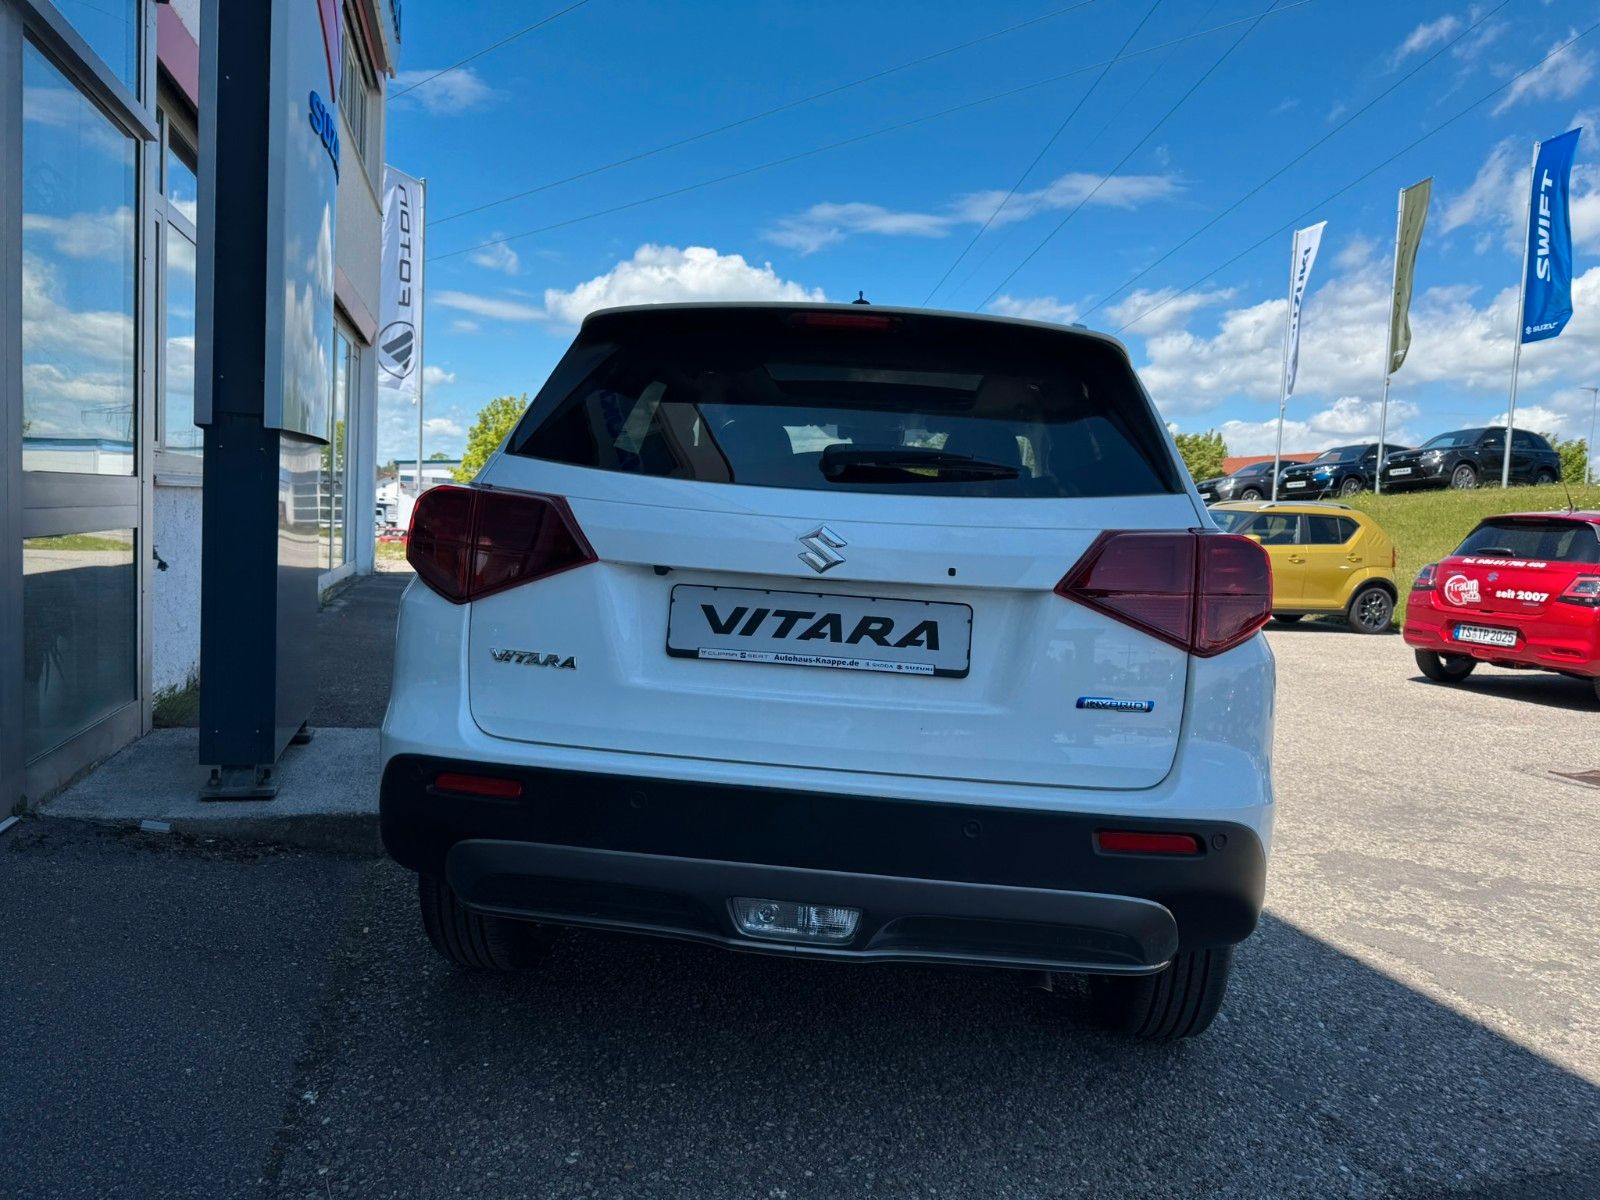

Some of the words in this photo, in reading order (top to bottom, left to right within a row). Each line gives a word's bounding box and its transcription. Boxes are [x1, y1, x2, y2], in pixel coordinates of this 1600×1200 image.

[1535, 168, 1553, 283] SWIFT
[1448, 579, 1478, 592] Traun
[1495, 588, 1516, 599] seit
[1516, 590, 1550, 602] 2007
[700, 603, 940, 651] VITARA
[1461, 626, 1473, 638] TS
[1478, 628, 1489, 640] TP
[1490, 631, 1515, 644] 2025
[489, 647, 577, 670] VITARA
[774, 654, 860, 668] Autohaus-Knappe.de
[1085, 699, 1144, 710] HYBRID
